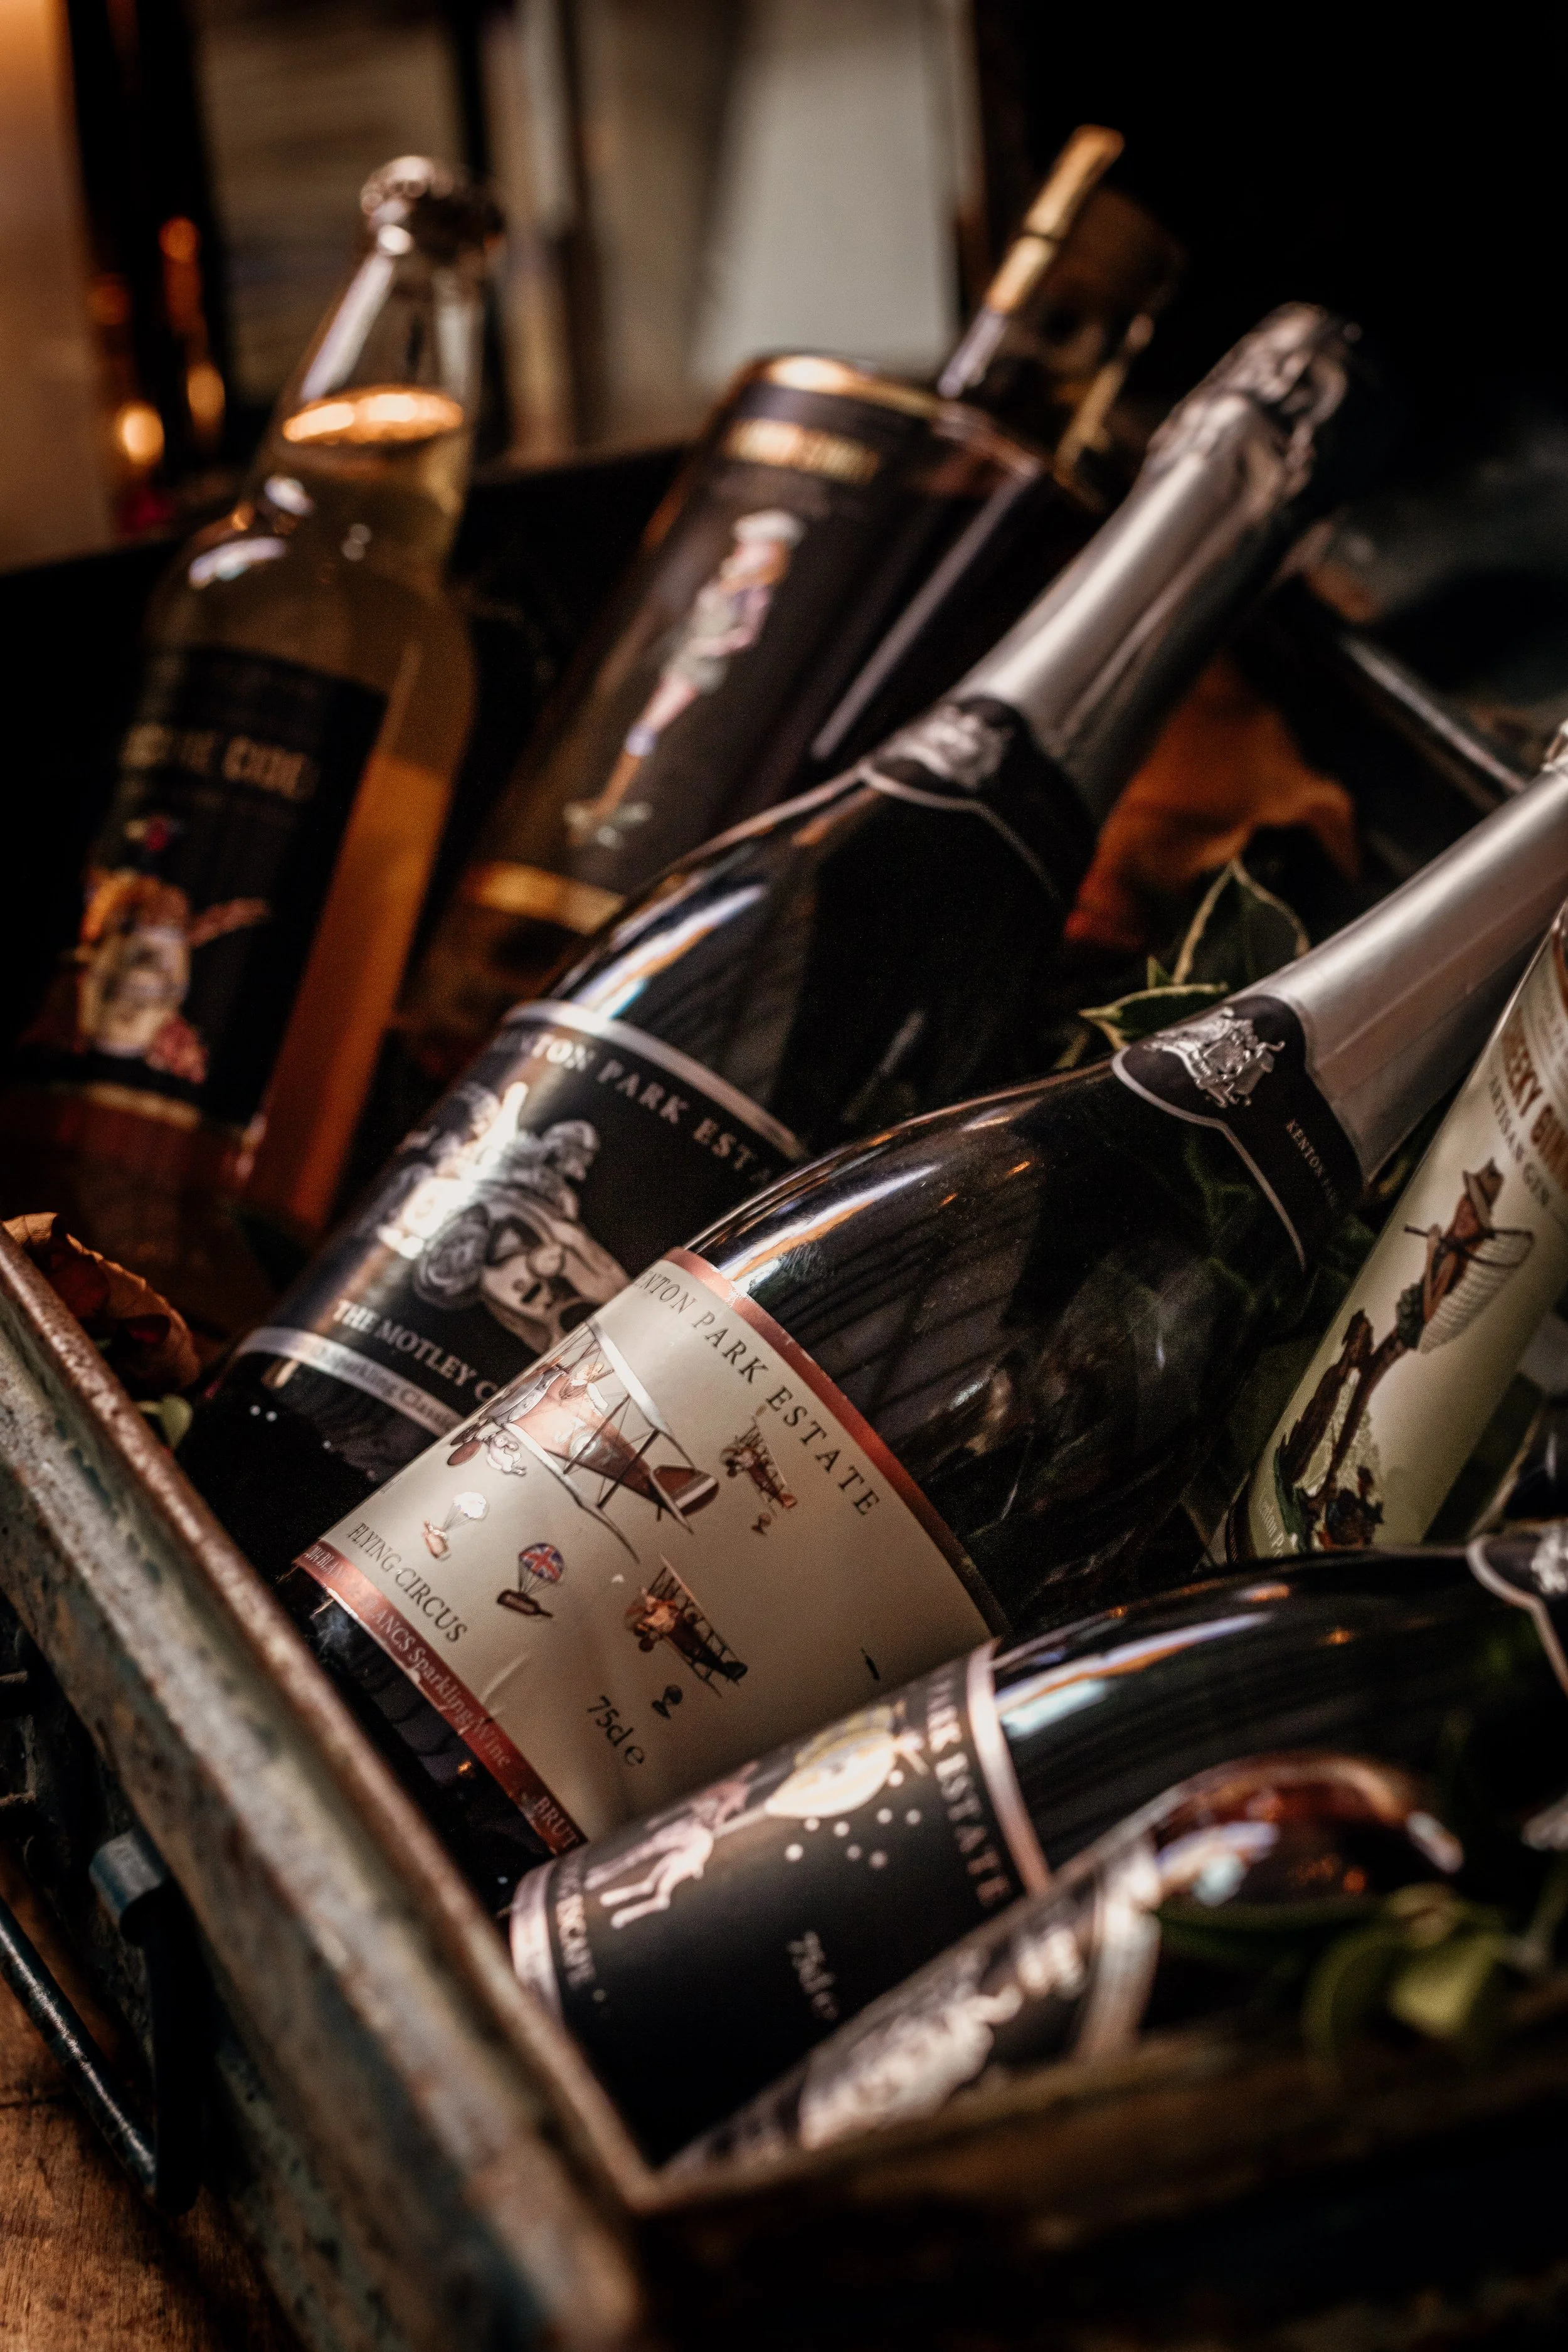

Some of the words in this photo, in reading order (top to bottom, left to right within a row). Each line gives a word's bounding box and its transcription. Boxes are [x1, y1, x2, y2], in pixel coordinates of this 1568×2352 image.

[597, 1059, 691, 1125] PARK
[692, 1117, 768, 1179] EST
[374, 1318, 478, 1387] MOTLEY
[692, 1310, 769, 1384] PARK
[766, 1386, 881, 1517] ESTATE
[347, 1522, 402, 1572] FLYING
[395, 1567, 468, 1644] CIRCUS
[408, 1646, 473, 1724] Sparkling
[471, 1716, 511, 1767] Wine
[532, 1796, 581, 1845] BRUT
[587, 1695, 633, 1747] 75cl
